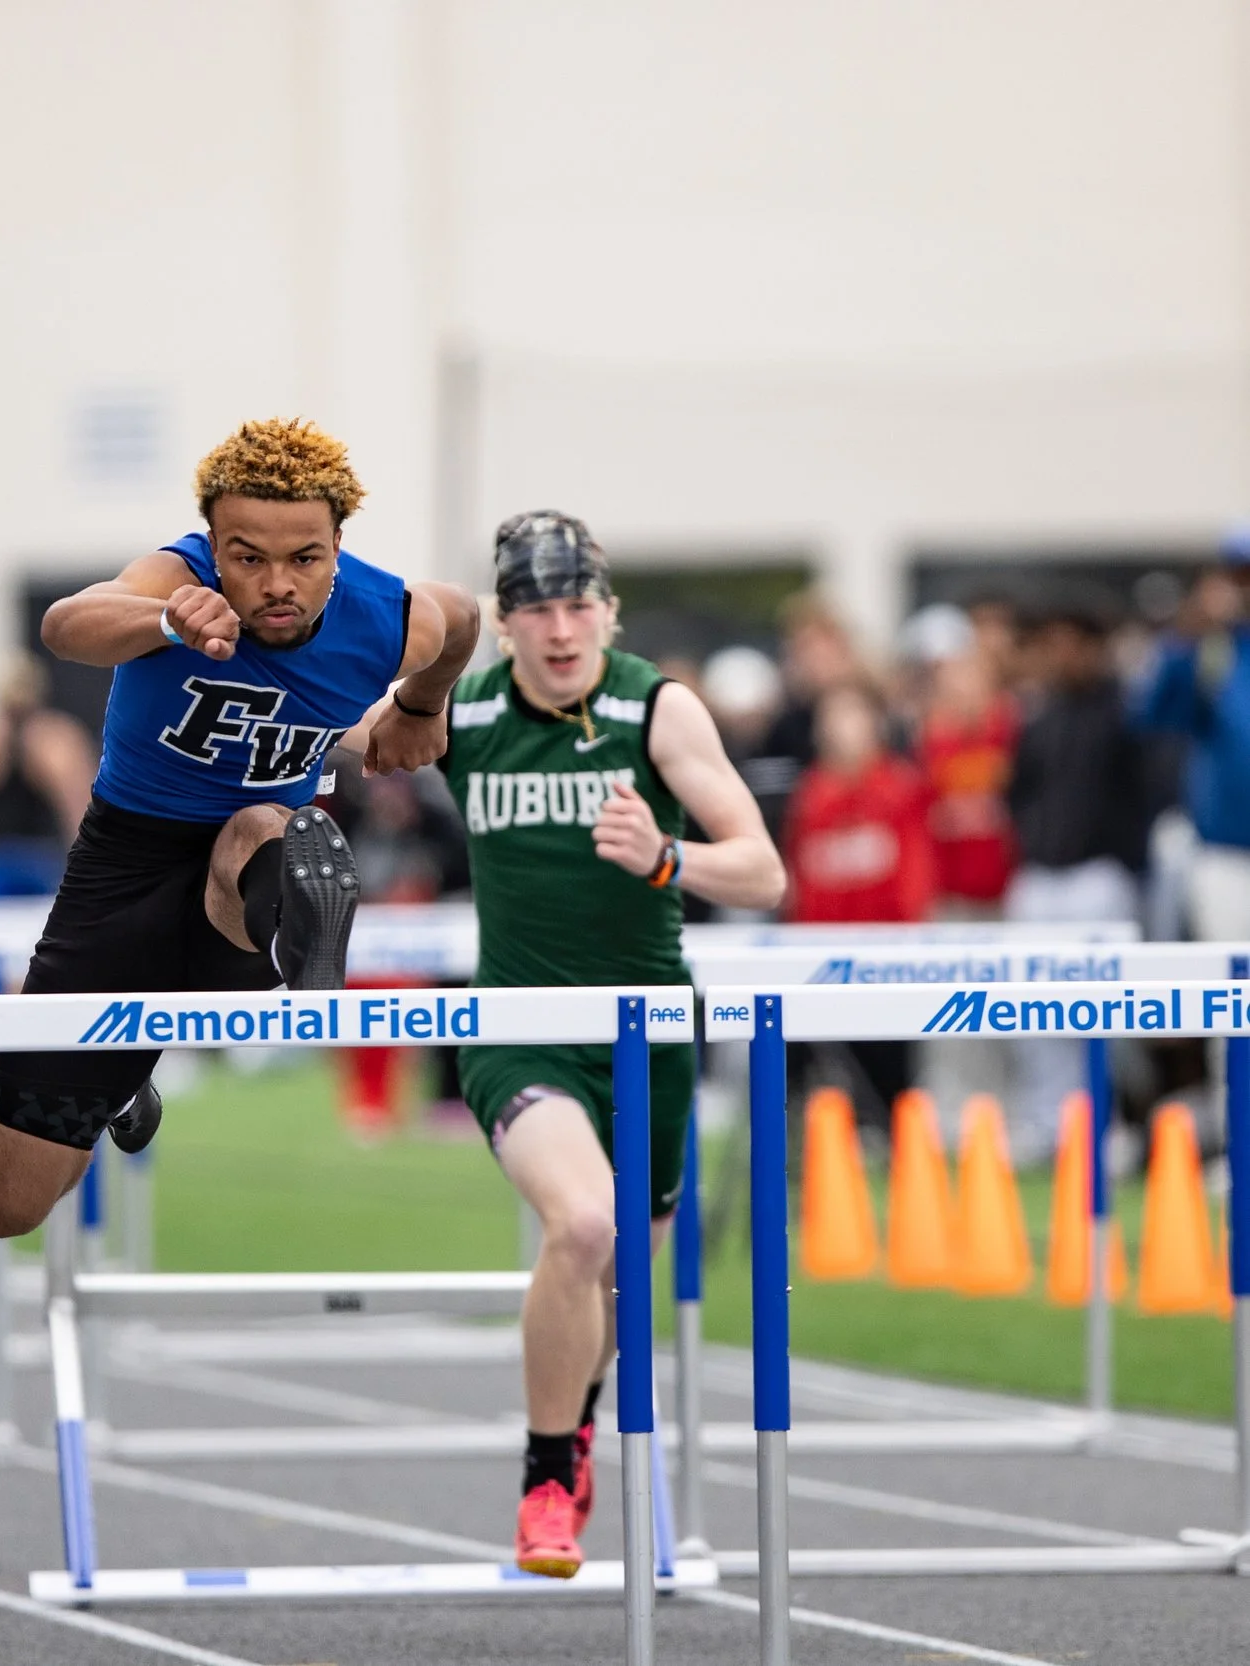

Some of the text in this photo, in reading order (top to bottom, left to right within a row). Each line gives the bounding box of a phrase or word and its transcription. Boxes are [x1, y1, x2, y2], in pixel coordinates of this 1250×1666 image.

[805, 955, 1121, 985] Memorial Field
[78, 997, 479, 1043] Memorial Field
[921, 988, 1250, 1032] Memorial Fi
